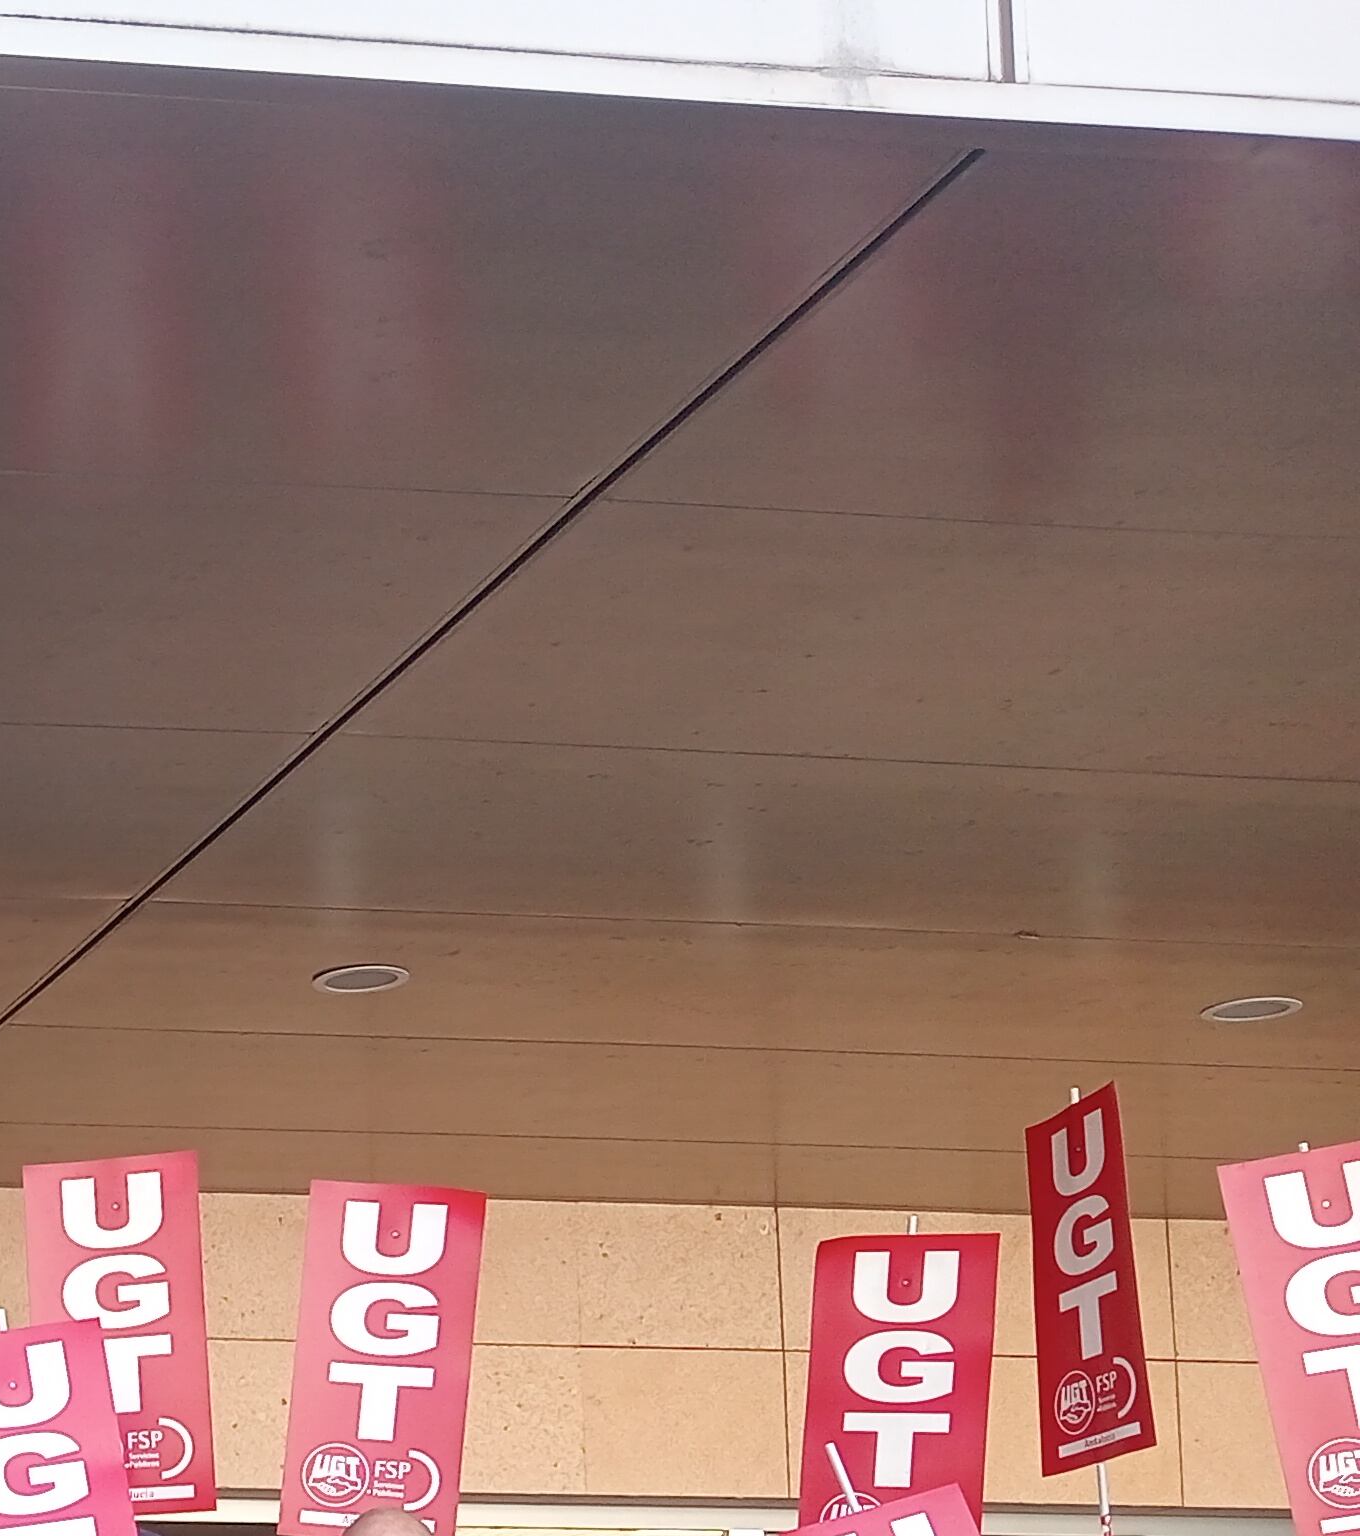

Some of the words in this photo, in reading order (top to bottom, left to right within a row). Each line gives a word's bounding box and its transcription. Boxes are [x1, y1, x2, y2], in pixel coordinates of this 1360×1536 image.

[60, 1171, 172, 1414] UGT
[1050, 1108, 1118, 1361] UGT
[328, 1200, 448, 1441] UGT
[842, 1250, 960, 1488] UGT
[1096, 1371, 1117, 1393] FSP
[127, 1430, 163, 1449] FSP
[313, 1454, 360, 1479] UGT
[375, 1461, 411, 1479] FSP
